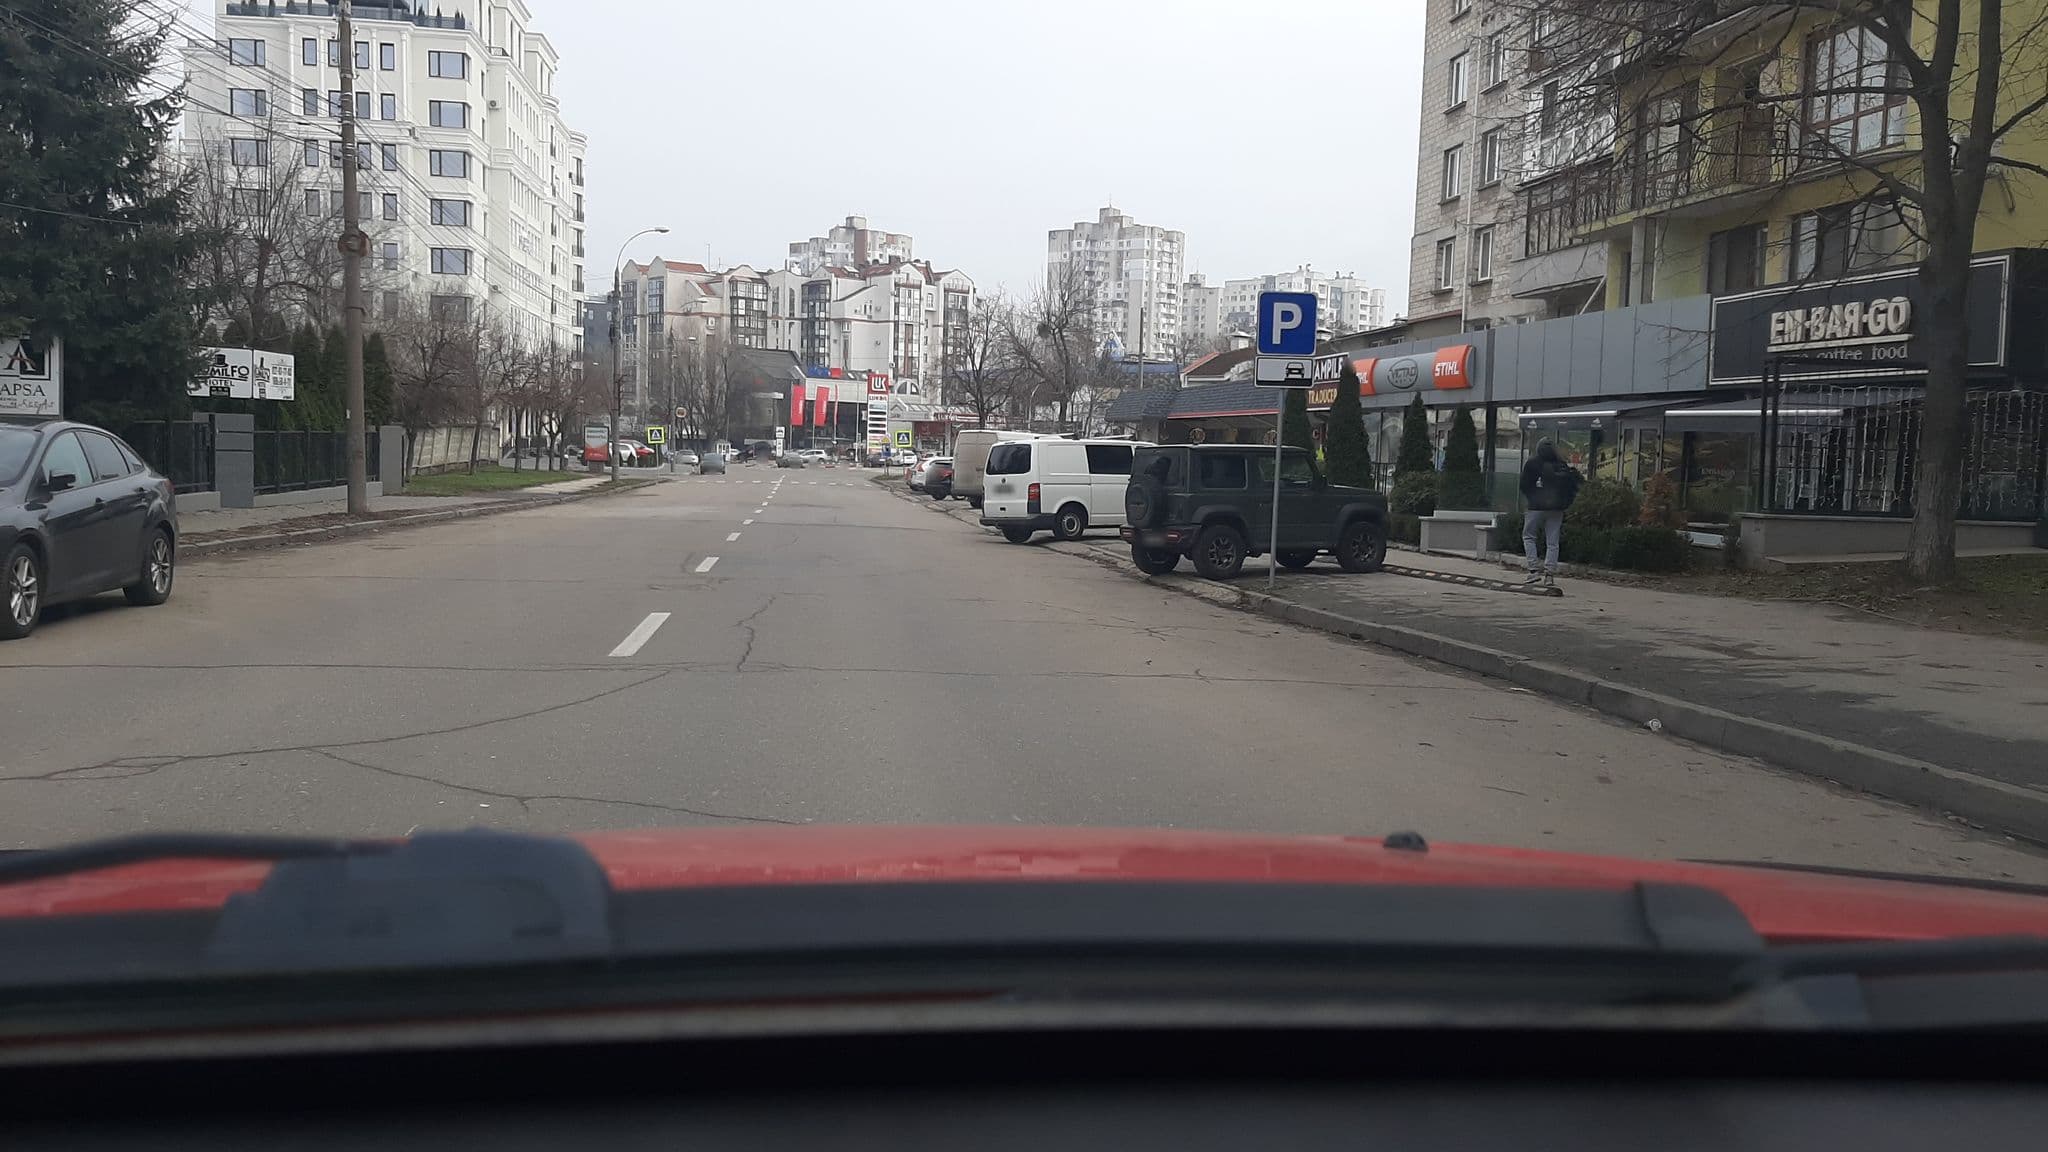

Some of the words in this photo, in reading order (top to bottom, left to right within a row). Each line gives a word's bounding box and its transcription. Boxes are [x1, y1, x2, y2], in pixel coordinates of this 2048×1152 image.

[1272, 302, 1302, 345] P
[1871, 342, 1908, 360] food
[202, 365, 250, 378] MILFO
[1434, 361, 1460, 377] STIHL
